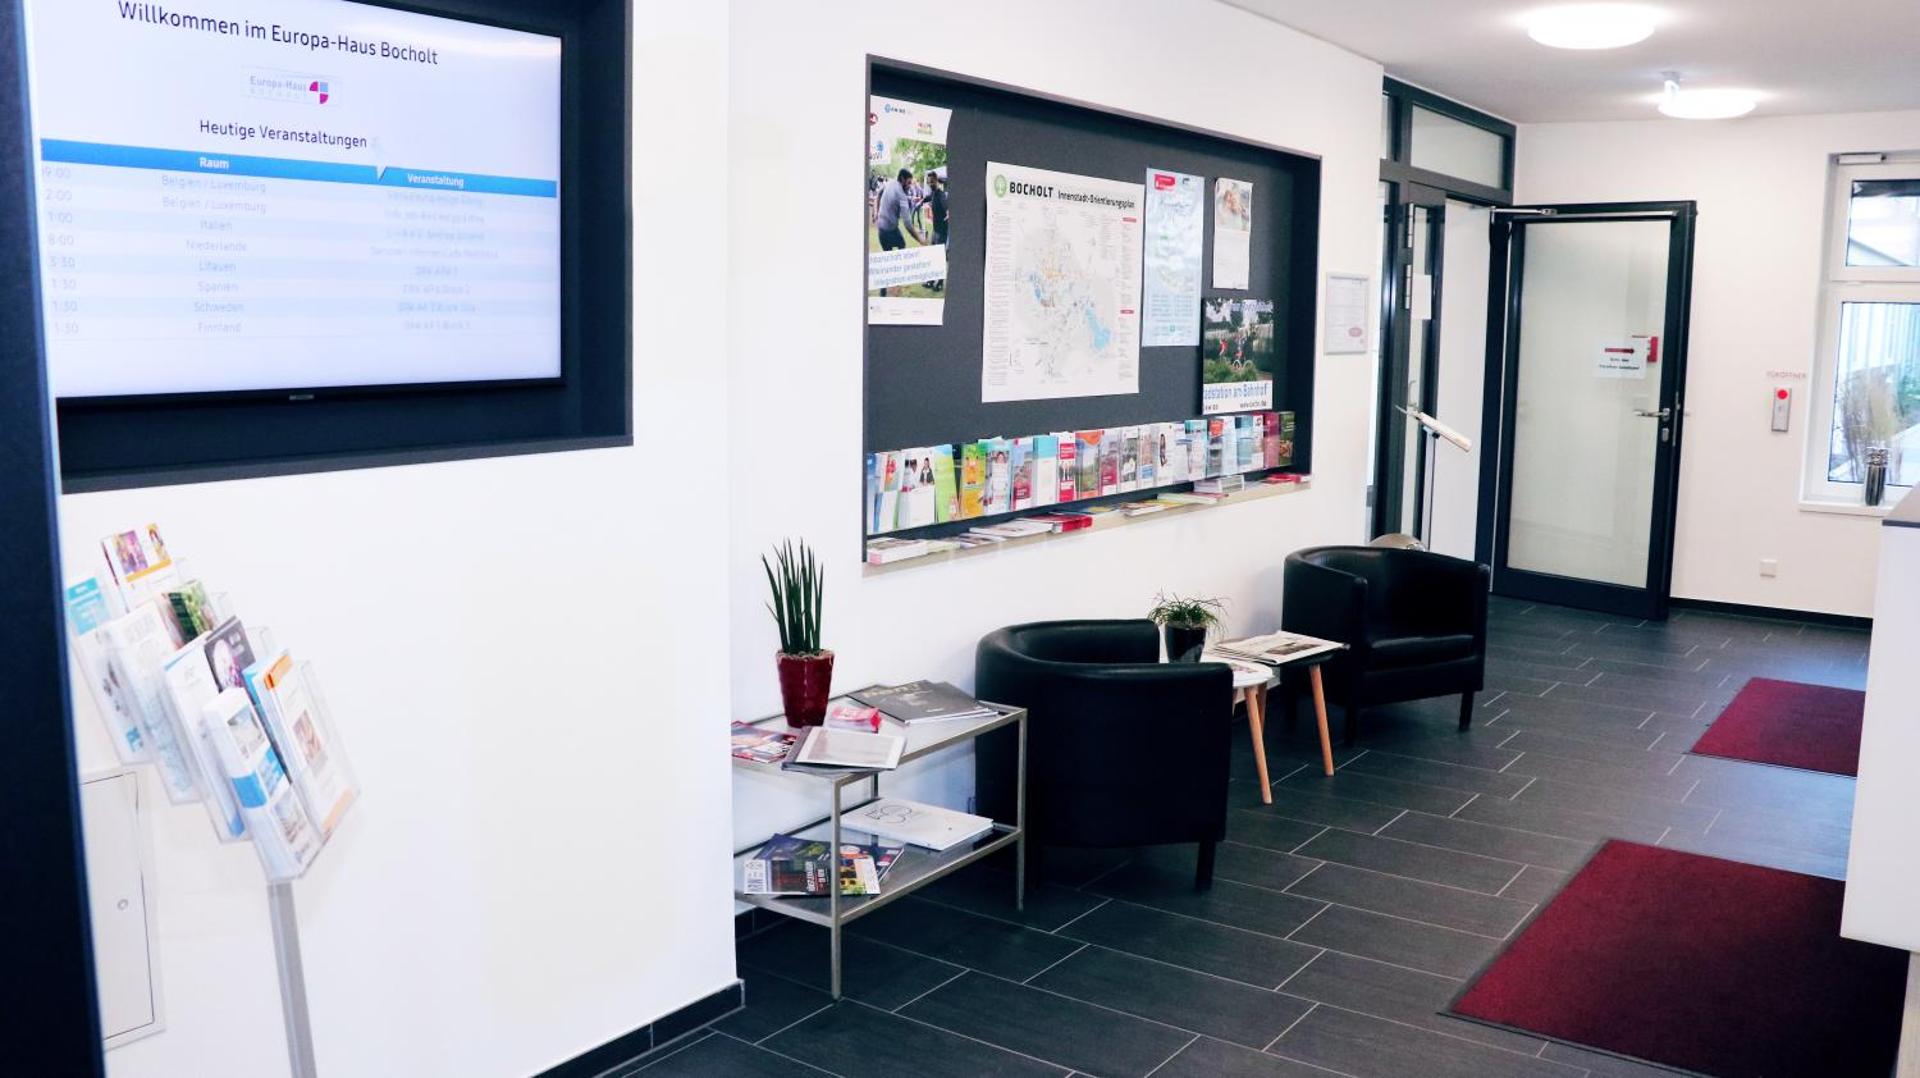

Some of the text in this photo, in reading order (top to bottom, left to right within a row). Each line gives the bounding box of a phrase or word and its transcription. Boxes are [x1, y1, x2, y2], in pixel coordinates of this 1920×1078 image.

[118, 0, 439, 65] Willkommen im Europa-Haus Bocholt
[199, 119, 368, 150] Heutige Veranstaltungen
[199, 156, 230, 170] Raum
[406, 173, 465, 189] Veranstaltung
[1009, 181, 1054, 198] BOCHOLT
